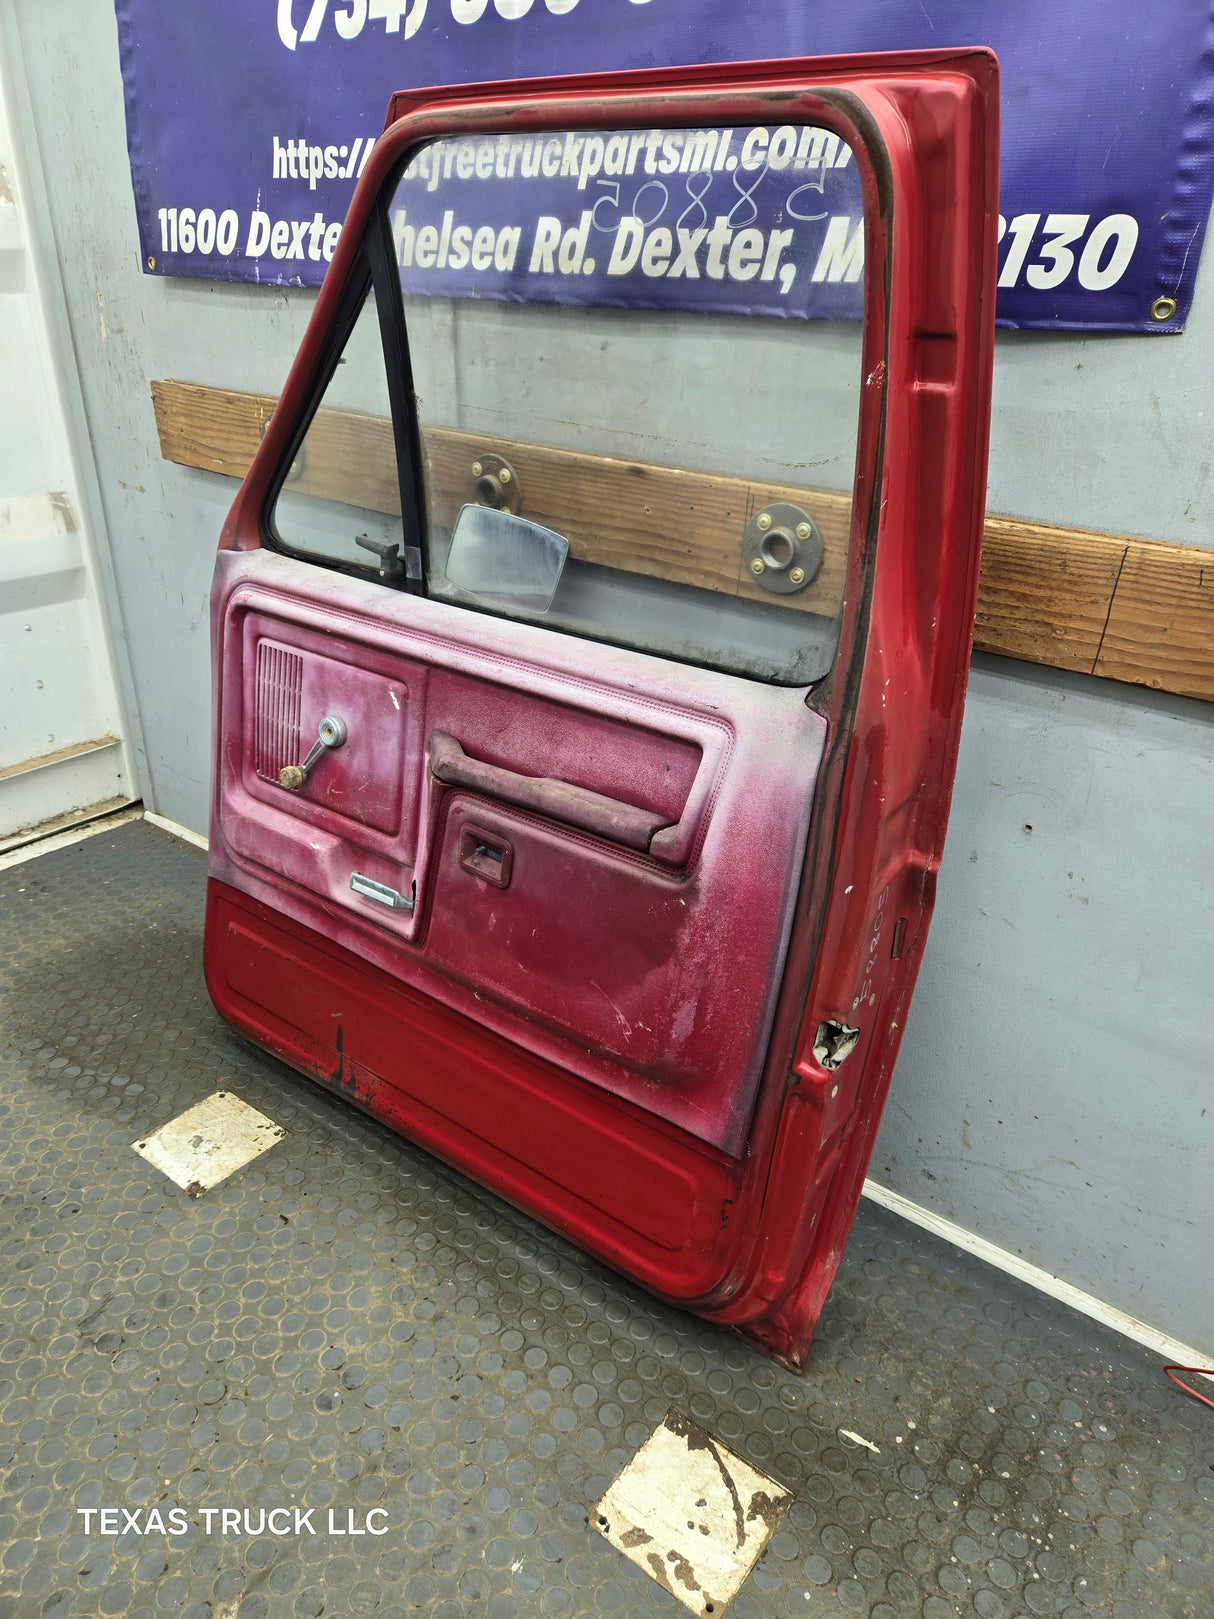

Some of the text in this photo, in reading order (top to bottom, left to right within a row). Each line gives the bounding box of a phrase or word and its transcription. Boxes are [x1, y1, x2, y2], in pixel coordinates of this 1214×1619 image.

[158, 207, 239, 256] 11600
[245, 211, 343, 262] Dexte
[392, 210, 521, 271] helsea
[529, 211, 596, 275] Rd.
[607, 216, 795, 294] Dexter,
[997, 213, 1139, 291] 130
